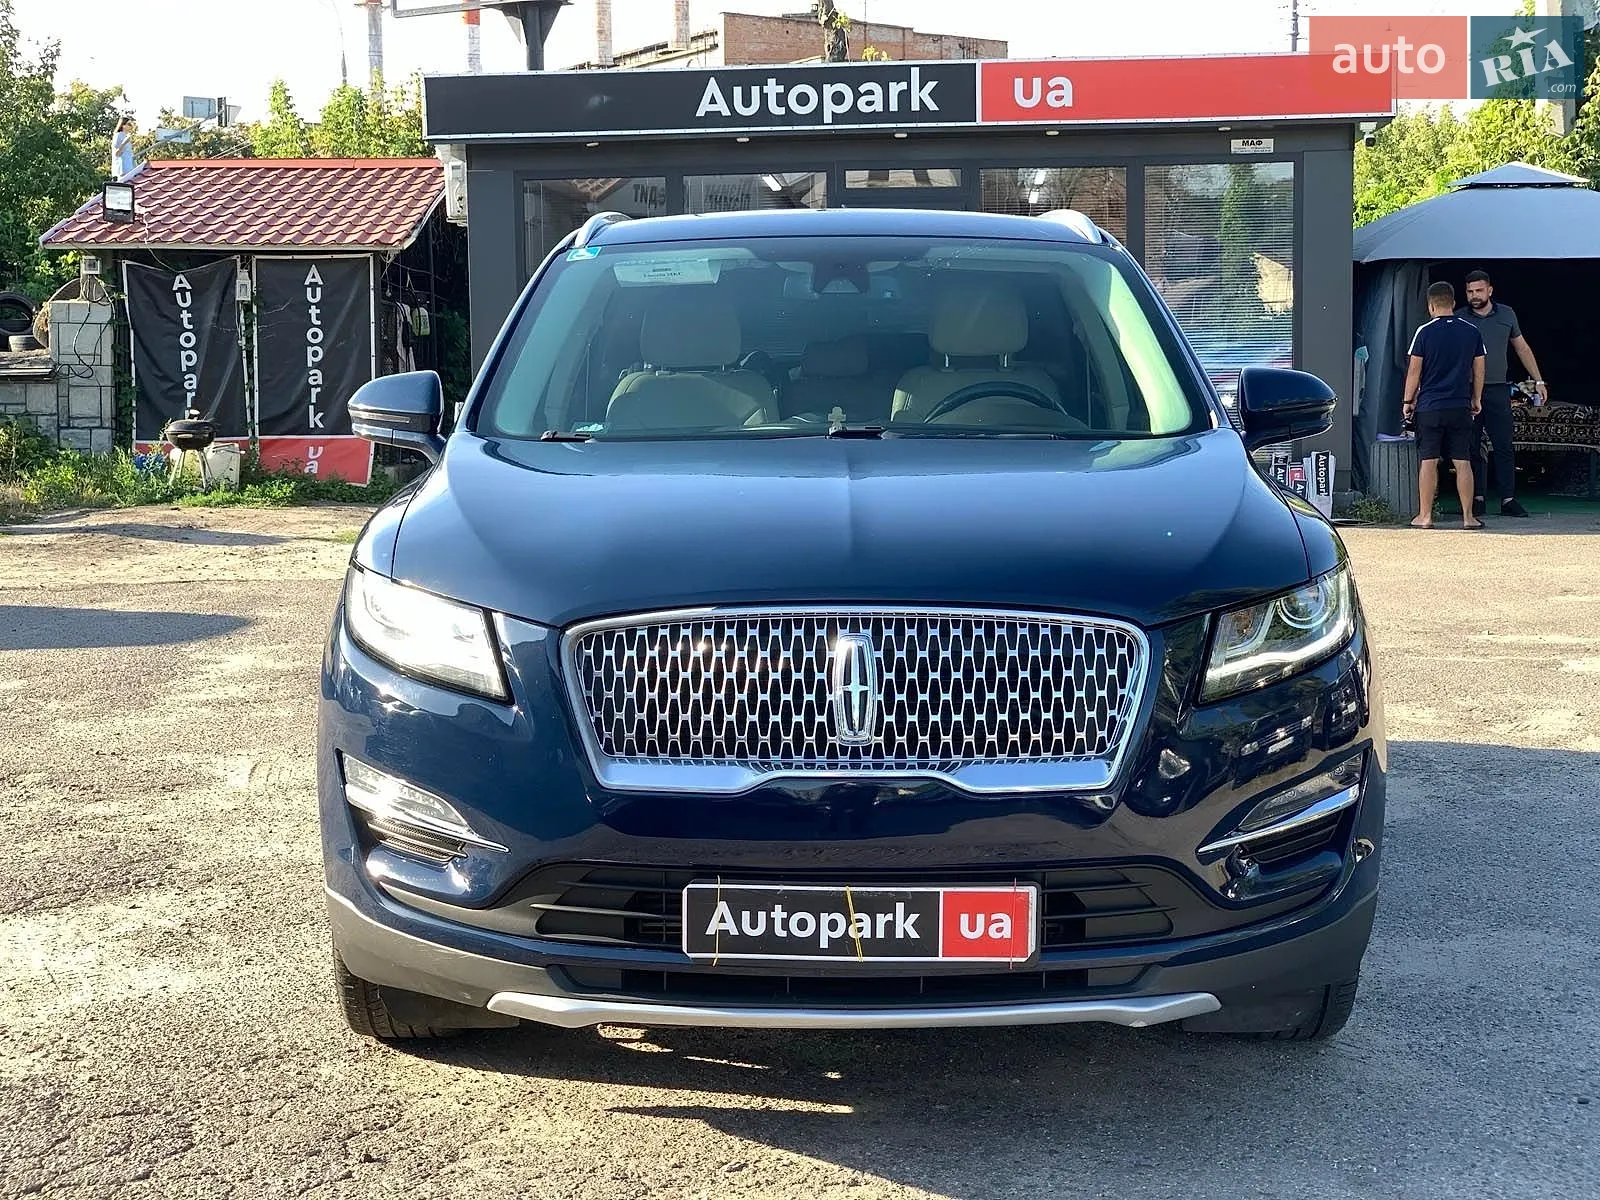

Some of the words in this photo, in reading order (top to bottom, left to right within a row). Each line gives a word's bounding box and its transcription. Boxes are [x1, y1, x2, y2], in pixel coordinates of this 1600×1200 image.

[695, 66, 940, 125] Autopark
[1013, 72, 1074, 109] ua
[303, 263, 325, 429] Autopark
[303, 445, 323, 475] ua
[705, 900, 921, 949] Autopark
[958, 910, 1013, 940] ua
